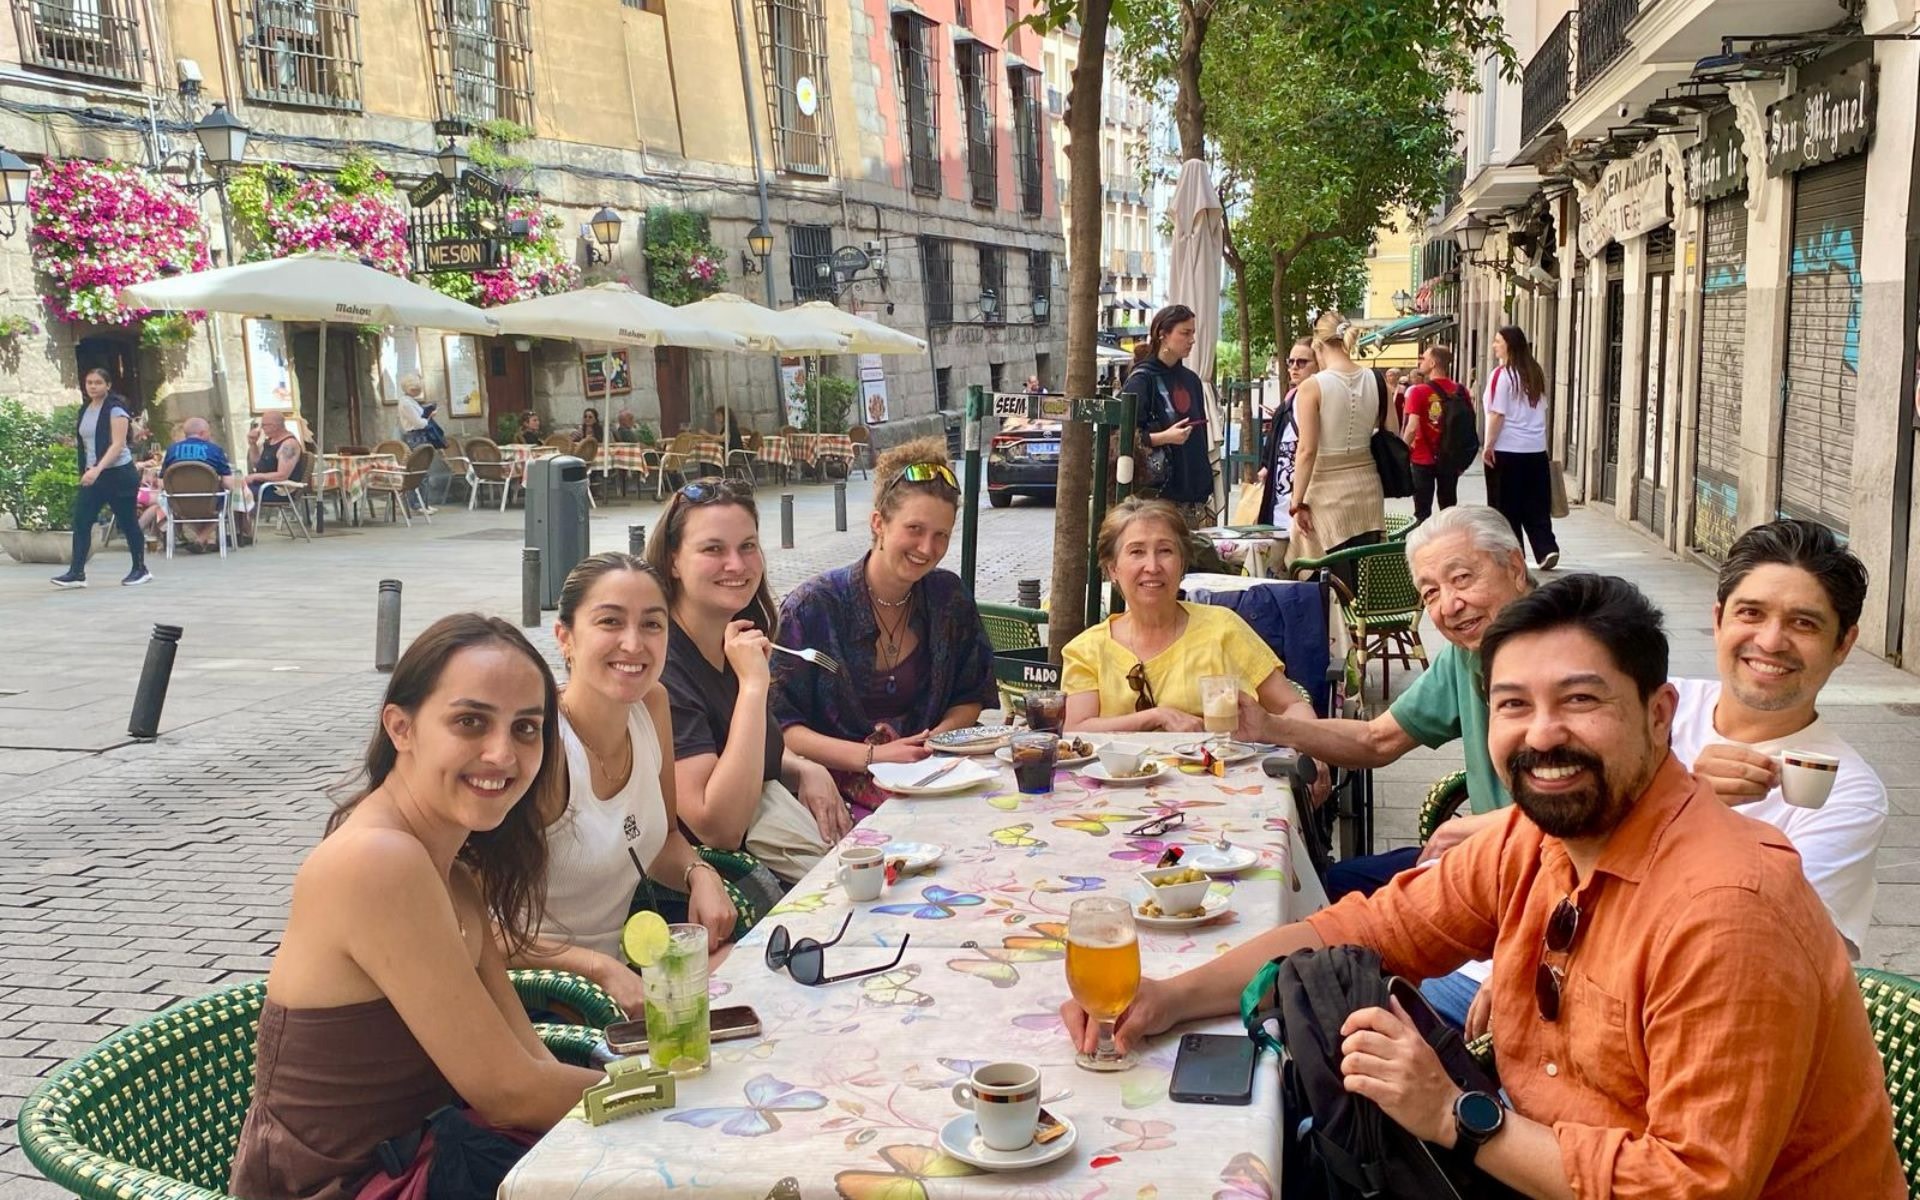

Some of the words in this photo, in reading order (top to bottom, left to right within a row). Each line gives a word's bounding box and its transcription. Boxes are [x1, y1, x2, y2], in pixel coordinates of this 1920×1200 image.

[1770, 109, 1798, 164] San
[1803, 79, 1865, 160] Miguel
[1727, 137, 1737, 177] de
[467, 175, 493, 198] CAVA
[428, 243, 482, 265] MESON
